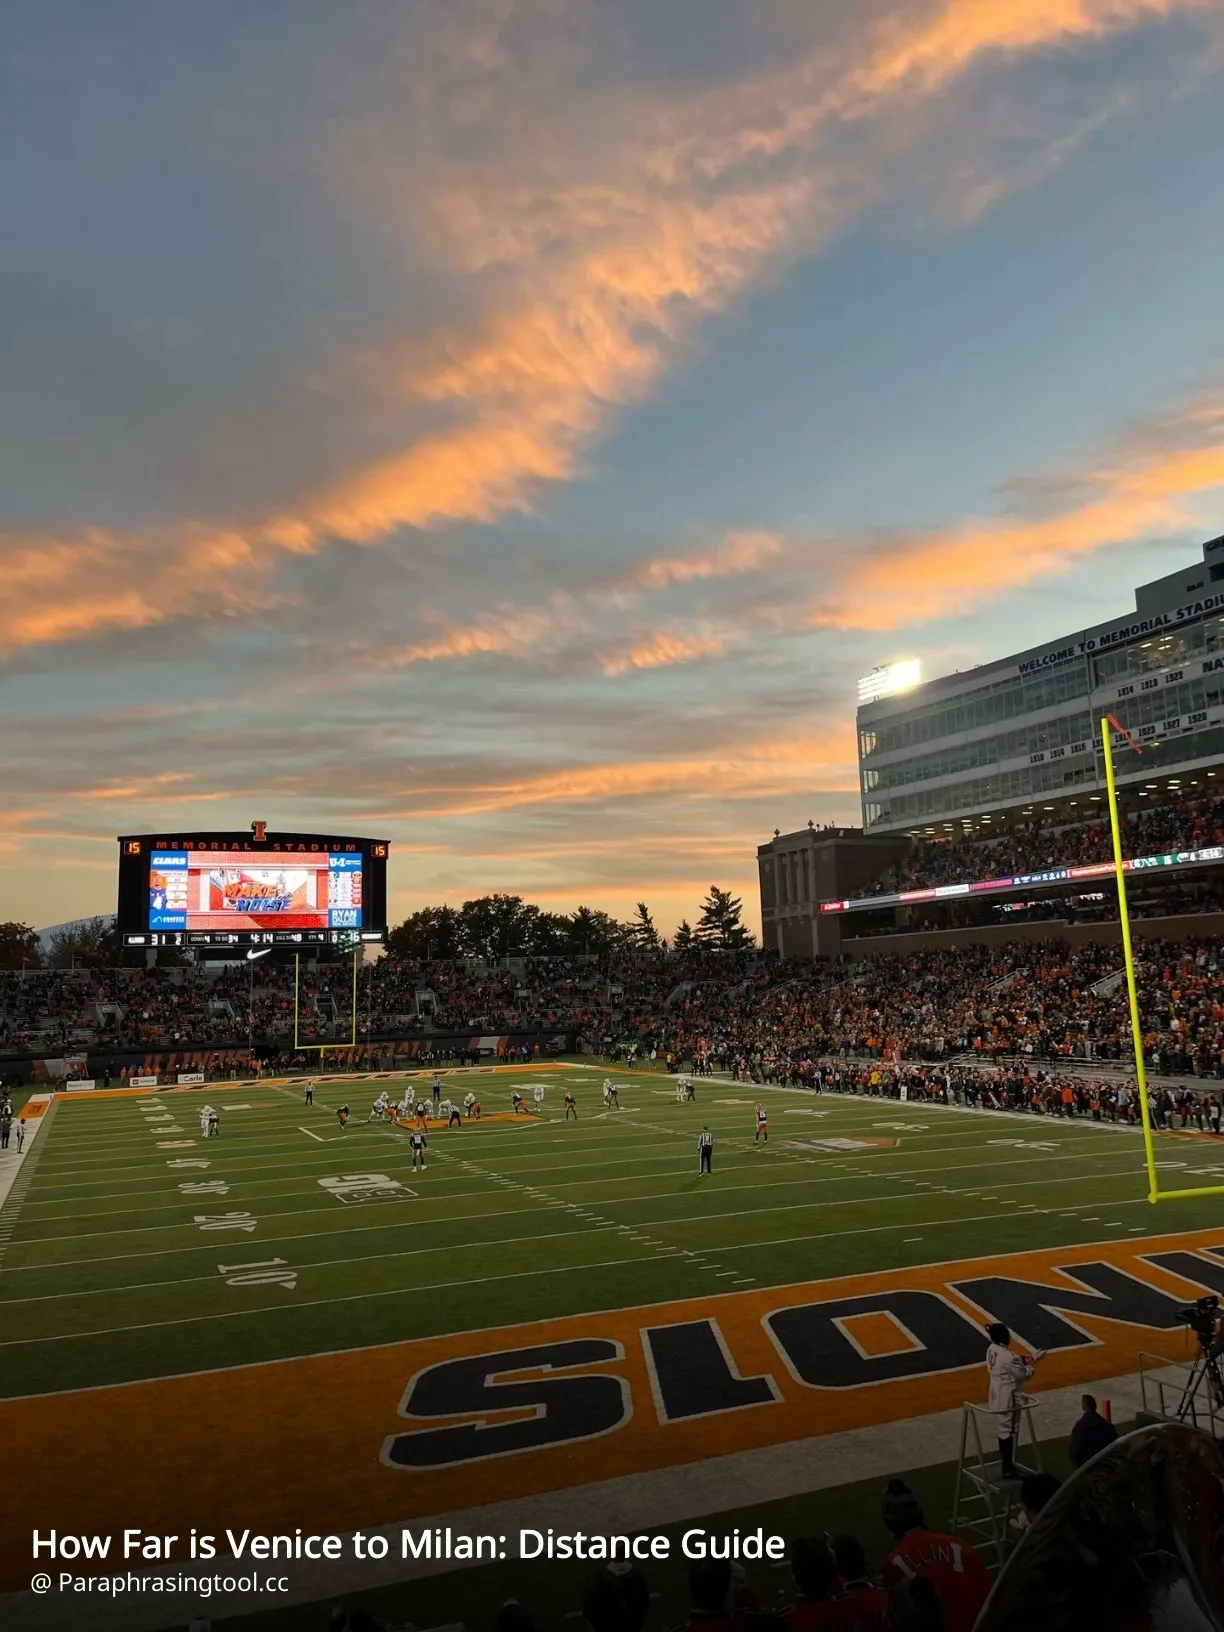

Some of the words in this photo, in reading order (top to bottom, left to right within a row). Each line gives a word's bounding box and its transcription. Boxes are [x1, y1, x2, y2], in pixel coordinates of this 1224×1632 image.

[1018, 646, 1075, 674] WELCOME
[1078, 639, 1096, 652] TO
[1100, 614, 1171, 645] MEMORIAL
[1203, 656, 1224, 673] NA
[128, 842, 140, 853] 15
[156, 841, 251, 851] MEMORIAL
[273, 843, 356, 852] STADIUM
[375, 845, 385, 856] 15
[223, 882, 278, 898] MAKE
[236, 897, 292, 911] NOISE
[250, 933, 273, 943] 4:14
[193, 1211, 258, 1232] 20
[217, 1257, 298, 1286] 10
